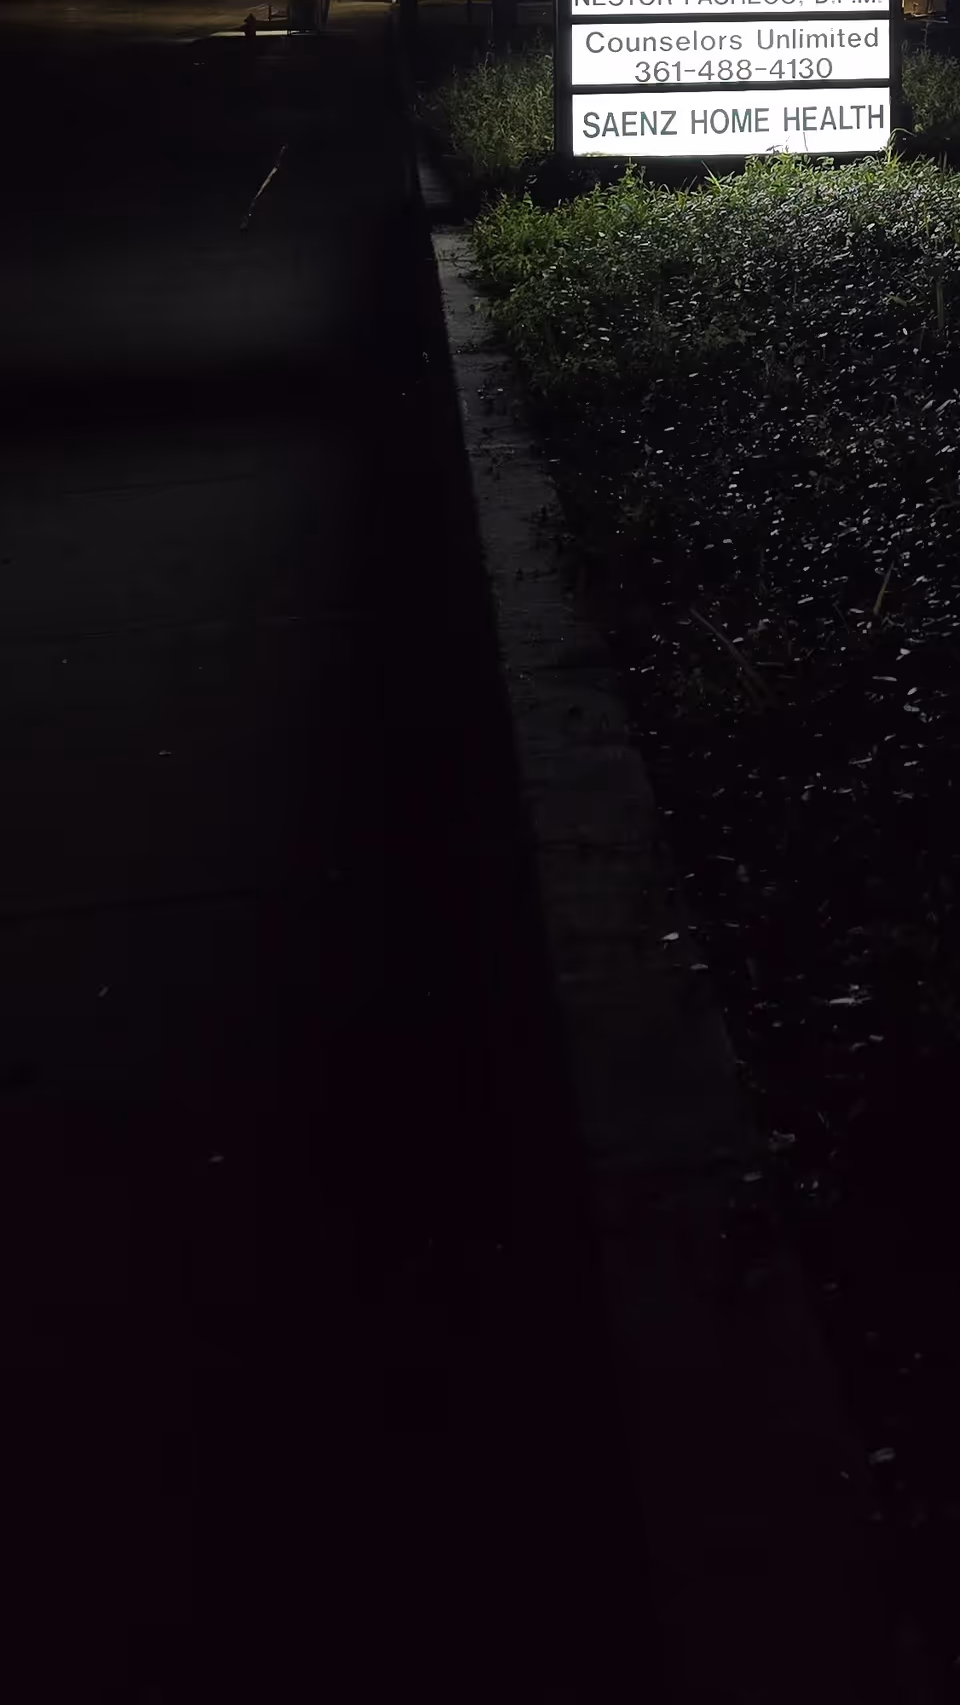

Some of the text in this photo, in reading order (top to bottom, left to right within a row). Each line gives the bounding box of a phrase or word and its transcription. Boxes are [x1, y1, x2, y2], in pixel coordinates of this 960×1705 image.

[586, 27, 878, 53] Counselors Unlimited
[635, 58, 833, 82] 361-488-4130
[583, 105, 883, 138] SAENZ HOME HEALTH
